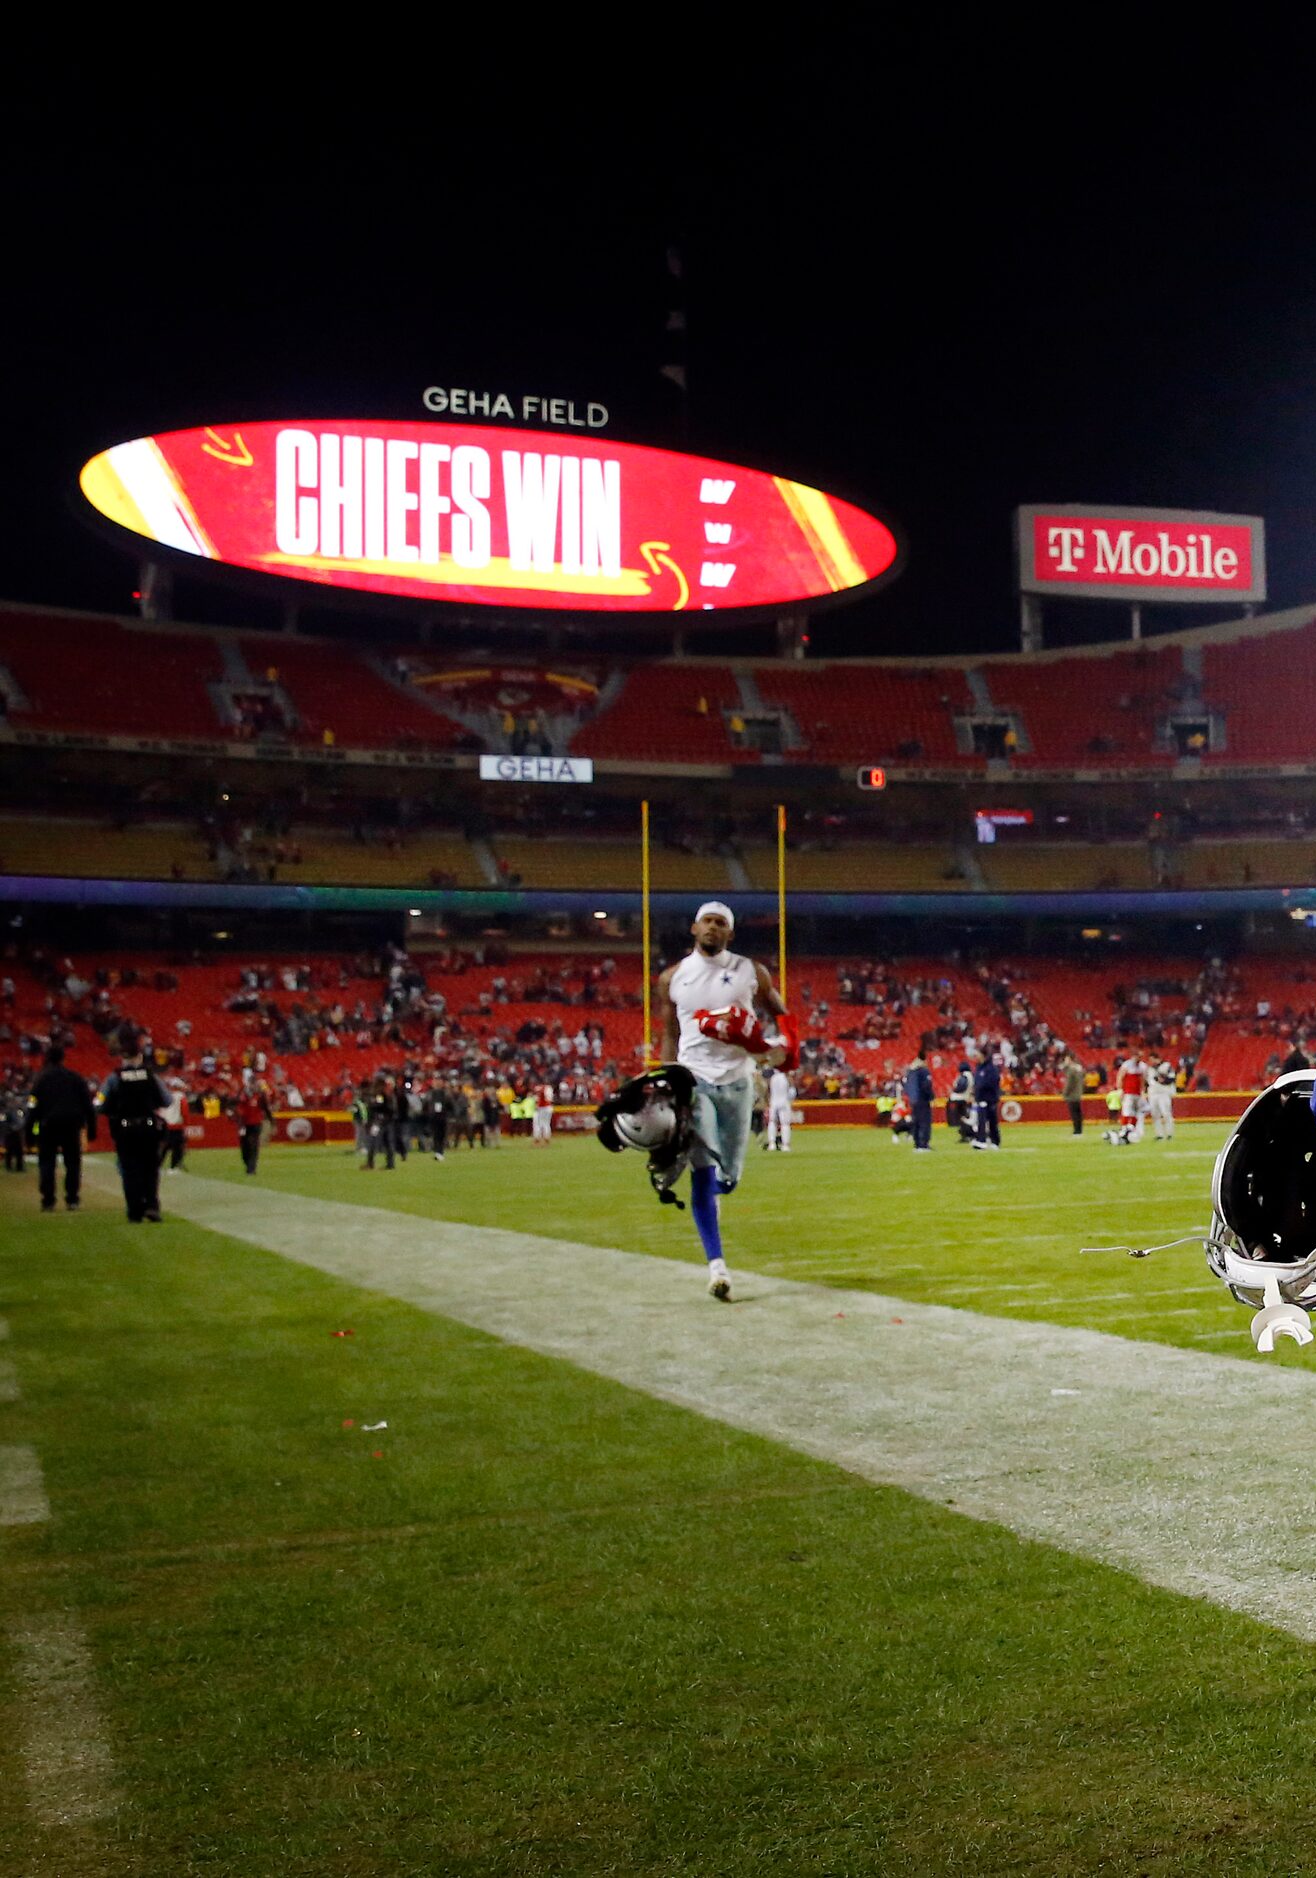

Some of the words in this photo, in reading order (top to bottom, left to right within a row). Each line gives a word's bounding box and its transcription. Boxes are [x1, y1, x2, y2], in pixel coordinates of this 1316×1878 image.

[422, 385, 515, 420] GEHA
[522, 395, 609, 428] FIELD
[275, 428, 492, 569] CHIEFS
[502, 450, 621, 578] WIN
[1048, 527, 1085, 573] T
[1092, 529, 1239, 580] Mobile
[496, 755, 576, 782] GEHA
[870, 767, 885, 787] 0
